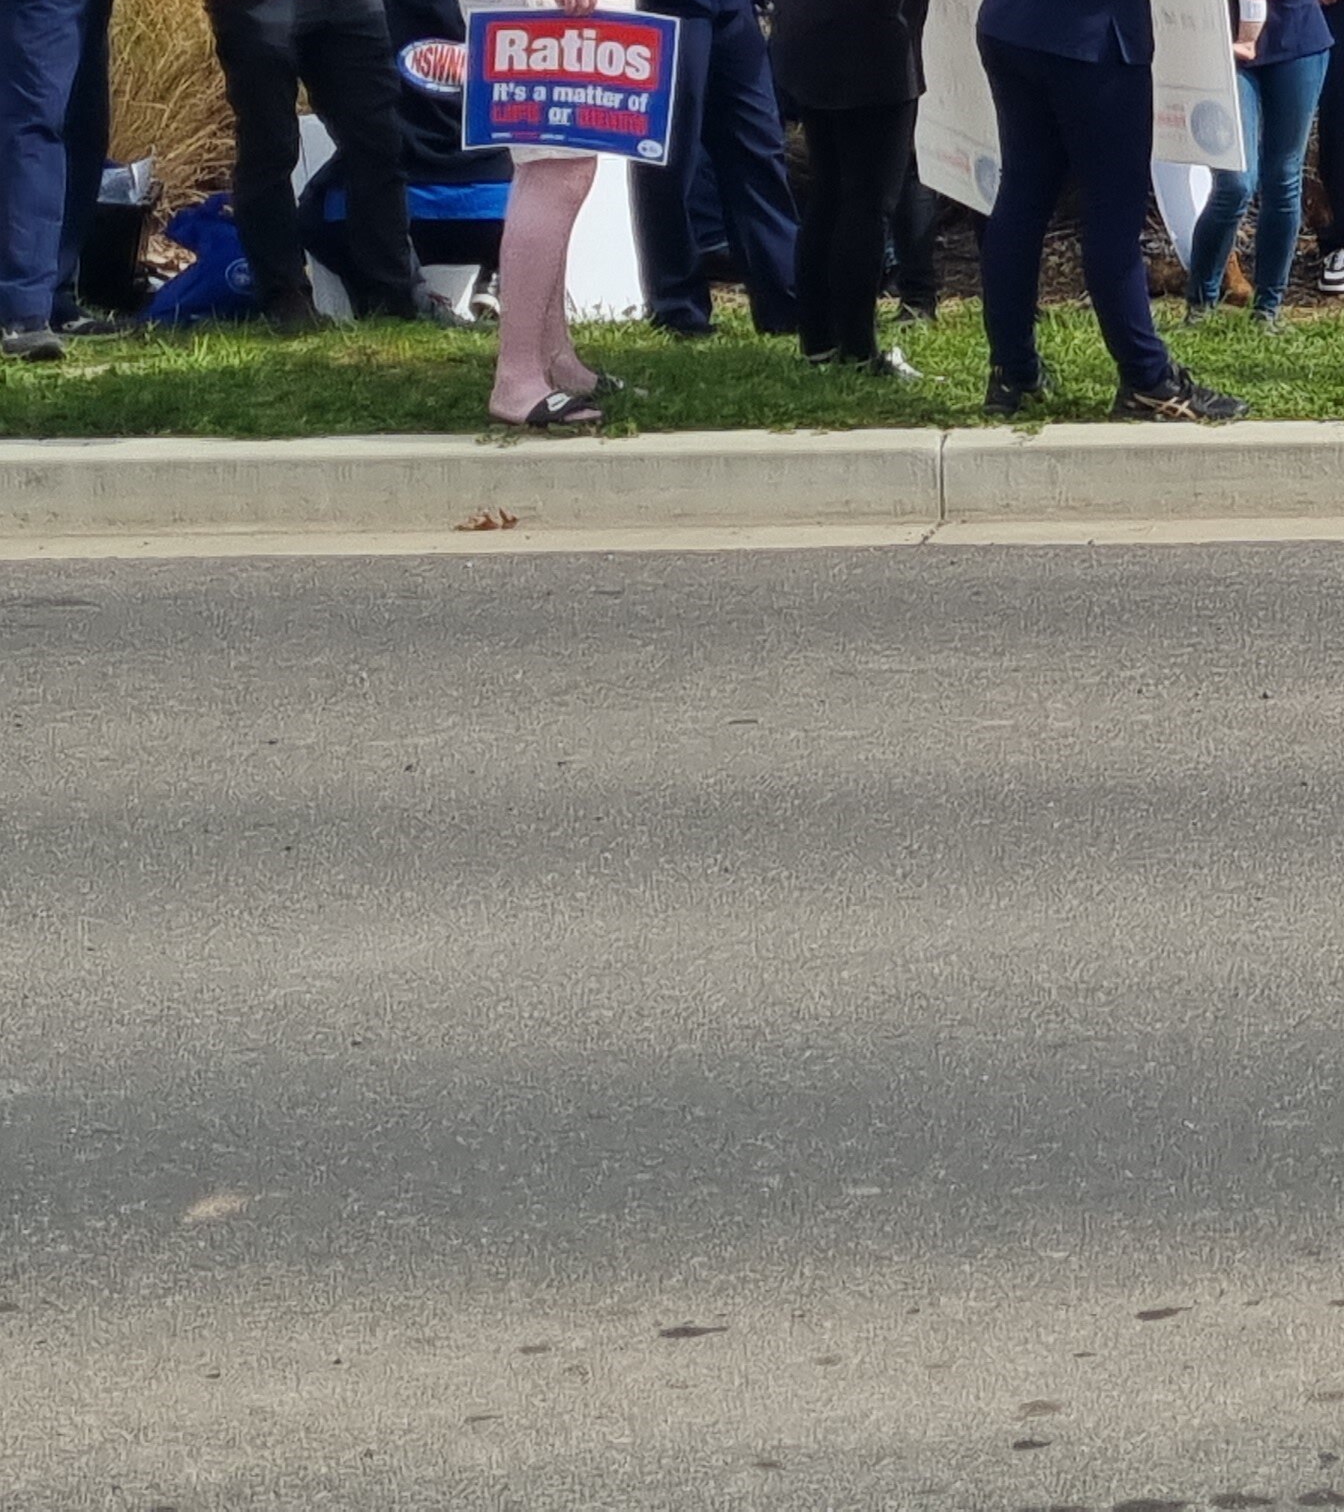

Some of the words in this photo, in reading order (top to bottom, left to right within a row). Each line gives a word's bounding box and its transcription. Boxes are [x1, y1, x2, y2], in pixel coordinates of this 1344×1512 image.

[411, 44, 466, 86] NSWN
[494, 28, 652, 81] Ratios
[493, 82, 527, 102] It's
[533, 85, 547, 102] a
[553, 84, 624, 109] matter
[628, 93, 649, 113] of
[548, 105, 572, 125] or
